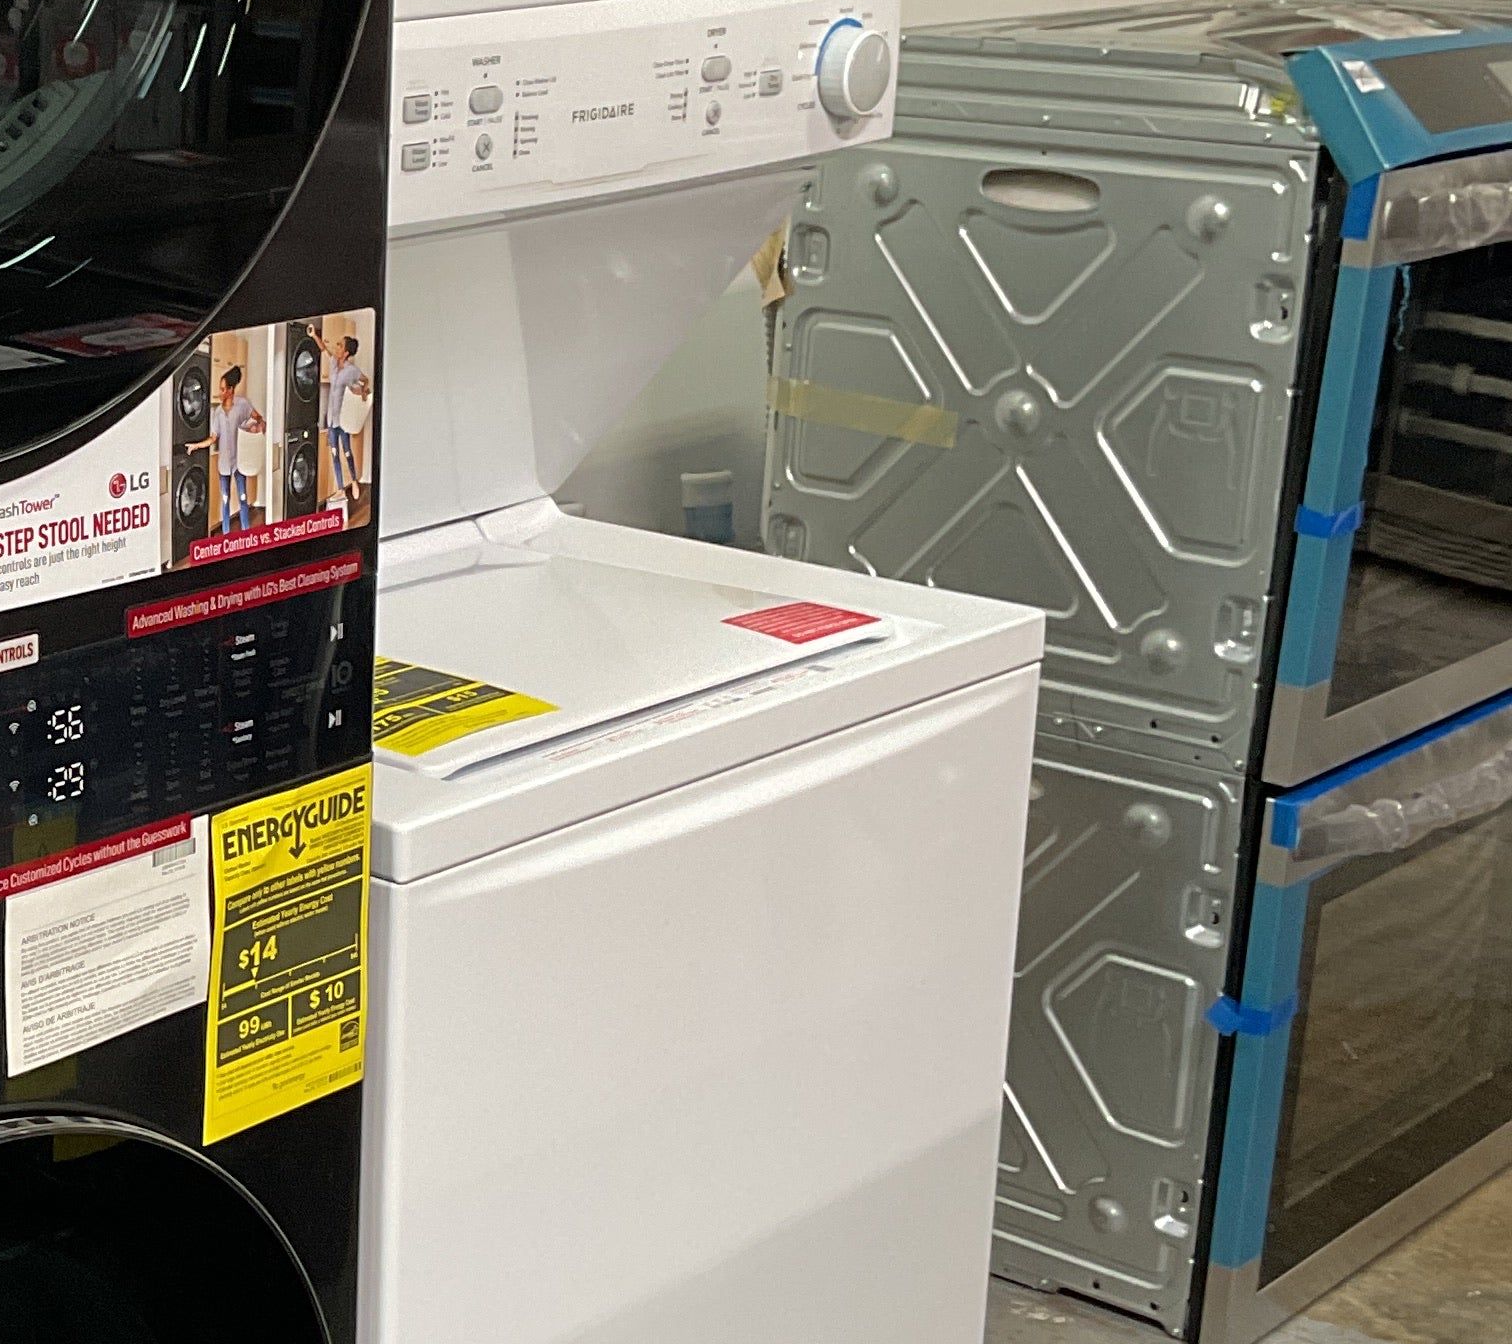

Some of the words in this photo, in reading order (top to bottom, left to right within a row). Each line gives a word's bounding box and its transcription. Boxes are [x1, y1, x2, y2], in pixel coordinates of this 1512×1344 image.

[472, 55, 502, 67] WASHER
[572, 102, 635, 124] FRIGIDAIRE
[130, 472, 150, 491] LG
[38, 516, 89, 550] STOOL
[93, 502, 151, 537] NEEDED
[193, 542, 222, 561] Center
[223, 533, 258, 554] Controls
[259, 532, 271, 546] vs.
[273, 523, 306, 542] Stacked
[306, 514, 340, 534] Controls
[33, 555, 48, 568] are
[48, 550, 65, 567] just
[66, 547, 80, 562] the
[81, 542, 101, 559] right
[102, 536, 127, 554] height
[16, 572, 40, 588] reach
[132, 609, 174, 631] Advanced
[174, 600, 209, 621] Washing
[209, 598, 217, 611] &
[218, 592, 243, 610] Drying
[244, 585, 262, 600] with
[262, 581, 279, 598] LG's
[279, 577, 297, 594] Best
[298, 569, 330, 589] Cleaning
[330, 562, 358, 581] System
[222, 785, 366, 861] ENERGYGUIDE
[10, 863, 62, 888] Customized
[62, 852, 92, 875] Cycles
[93, 843, 125, 861] without
[126, 837, 141, 851] the
[141, 821, 187, 847] Guesswork
[227, 894, 252, 911] Compare
[252, 912, 281, 930] Estimated
[281, 905, 299, 922] Yearly
[299, 899, 319, 915] Energy
[320, 892, 334, 905] Cost
[21, 924, 69, 945] ARBITRATION
[69, 912, 96, 931] NOTICE
[238, 934, 278, 970] $14
[21, 977, 38, 991] AVIS
[309, 989, 321, 1010] $
[325, 981, 345, 1003] 10
[23, 1020, 44, 1034] AVISO
[45, 1015, 56, 1029] DE
[56, 1002, 96, 1022] ARBITRAJE
[239, 1015, 261, 1040] 99
